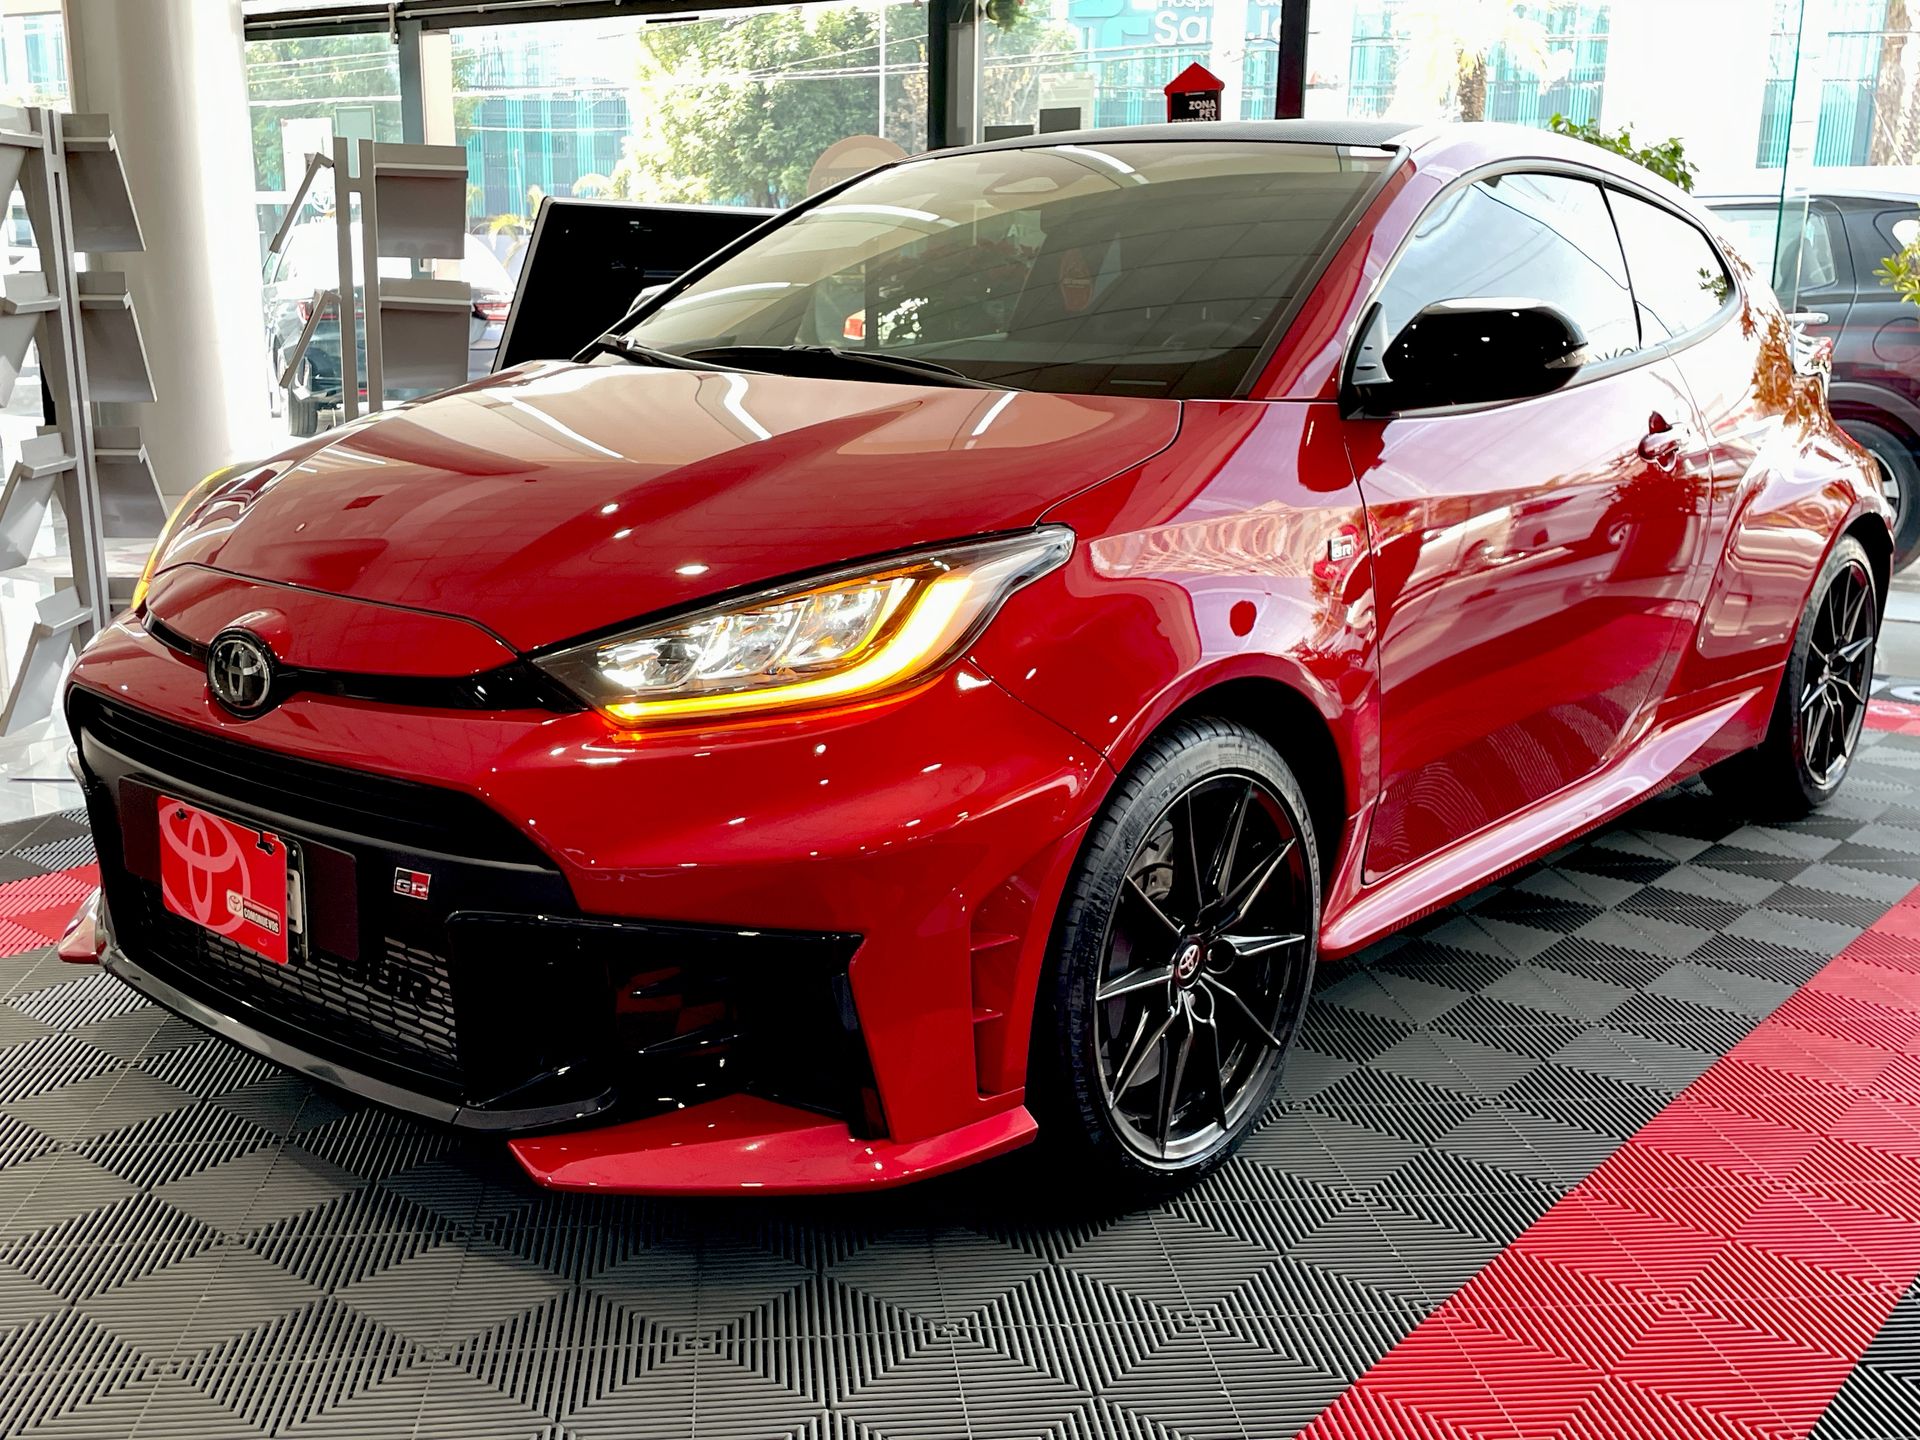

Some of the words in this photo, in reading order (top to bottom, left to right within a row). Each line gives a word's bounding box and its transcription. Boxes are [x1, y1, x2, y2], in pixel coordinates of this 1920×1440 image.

[1188, 99, 1217, 110] ZONA
[1199, 108, 1217, 118] PET
[396, 878, 427, 897] GR
